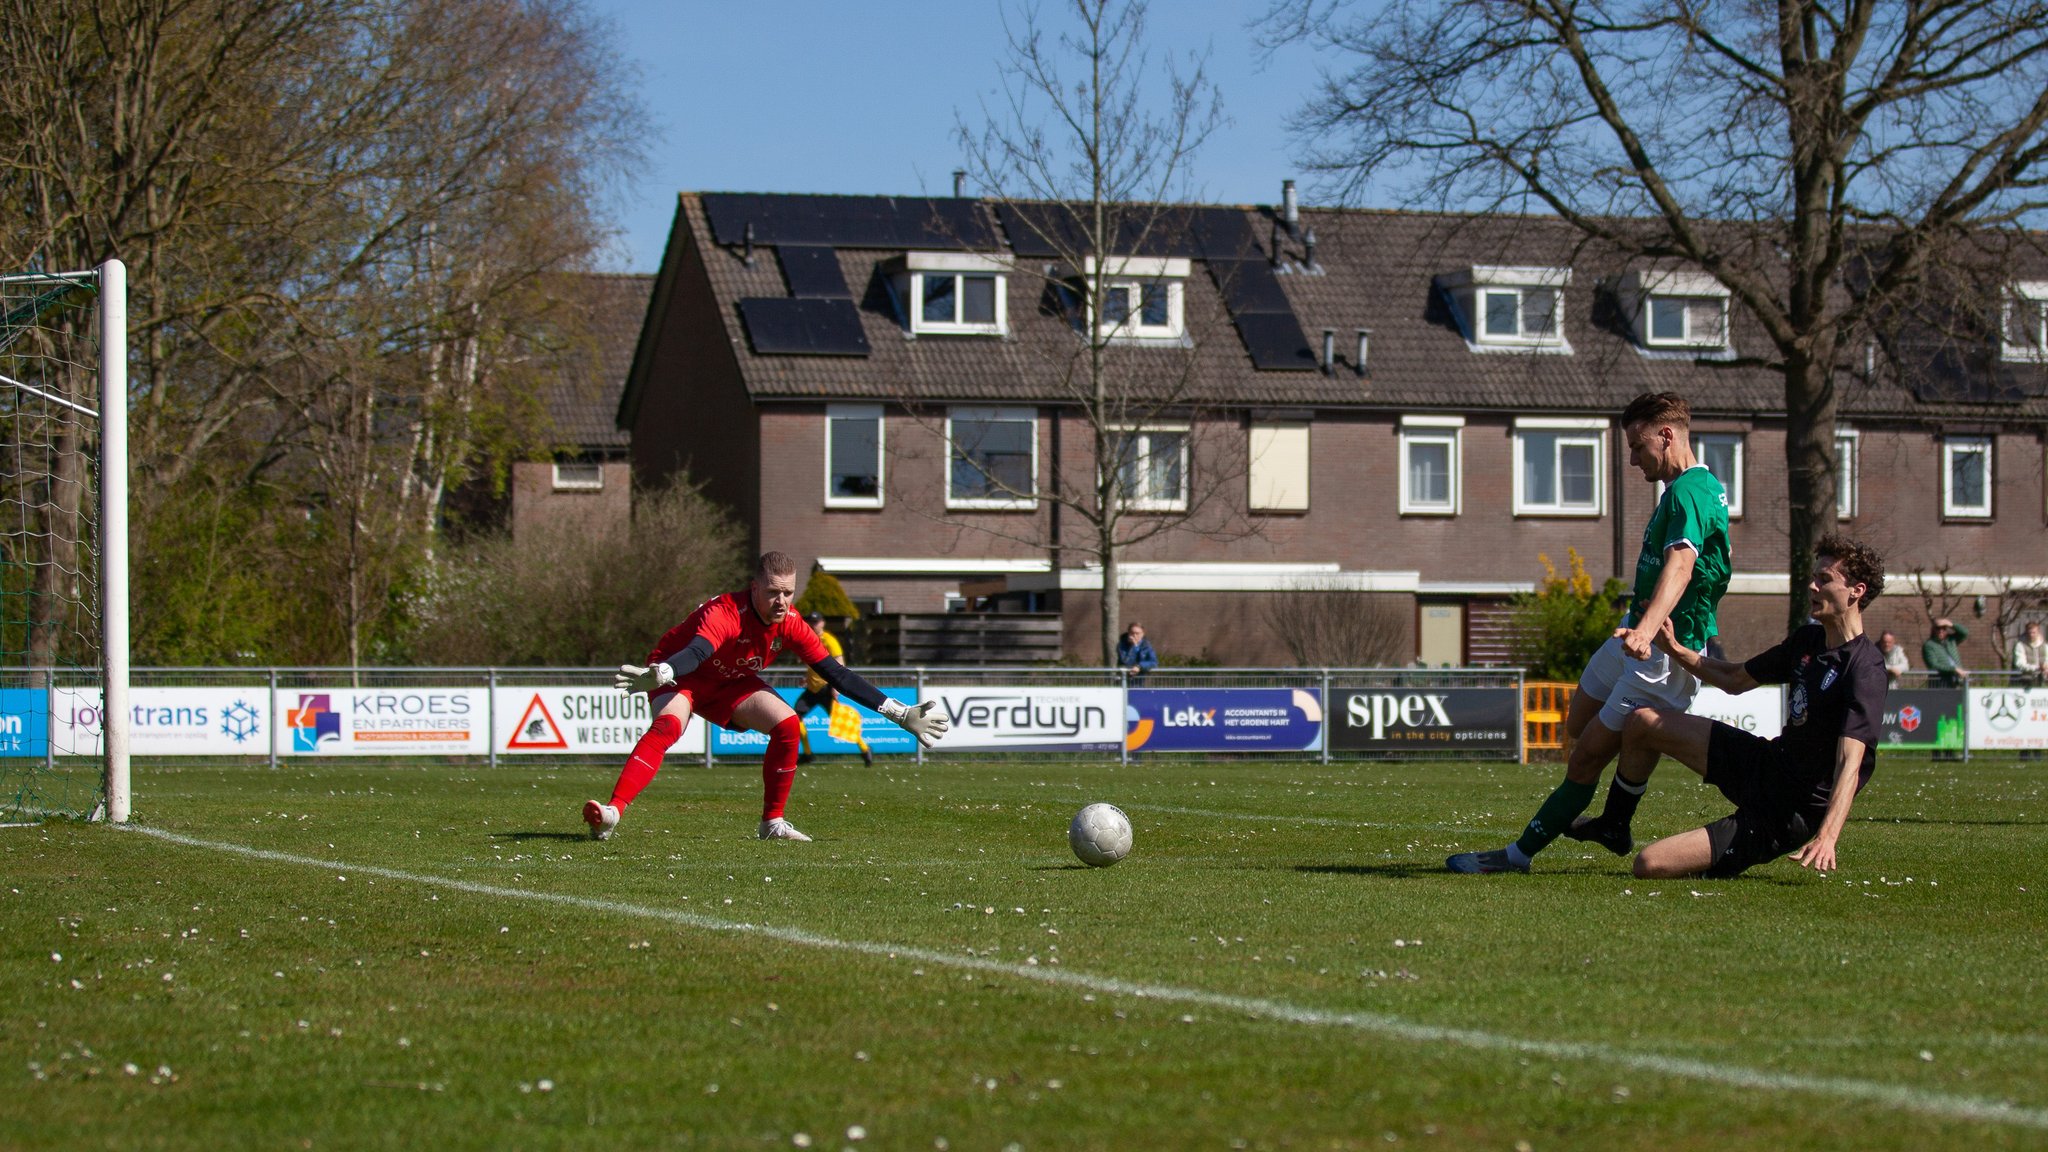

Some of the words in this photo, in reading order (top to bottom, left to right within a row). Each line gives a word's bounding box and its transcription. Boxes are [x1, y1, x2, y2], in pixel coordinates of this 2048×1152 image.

[353, 694, 470, 714] KROES
[563, 695, 653, 720] SCHUUR
[1224, 709, 1277, 717] ACCOUNTANTS
[1278, 709, 1287, 717] IN
[69, 704, 208, 730] jotrans
[353, 719, 375, 729] EN
[381, 719, 470, 729] PARTNERS
[941, 696, 1105, 737] Verduyn
[1163, 706, 1216, 727] Lekx
[1224, 718, 1239, 726] HET
[1240, 718, 1269, 726] GROENE
[1270, 718, 1290, 726] HART
[1347, 693, 1454, 740] spex
[1391, 731, 1402, 739] in
[1406, 731, 1425, 739] the
[1429, 731, 1450, 741] city
[1455, 731, 1507, 741] opticiens
